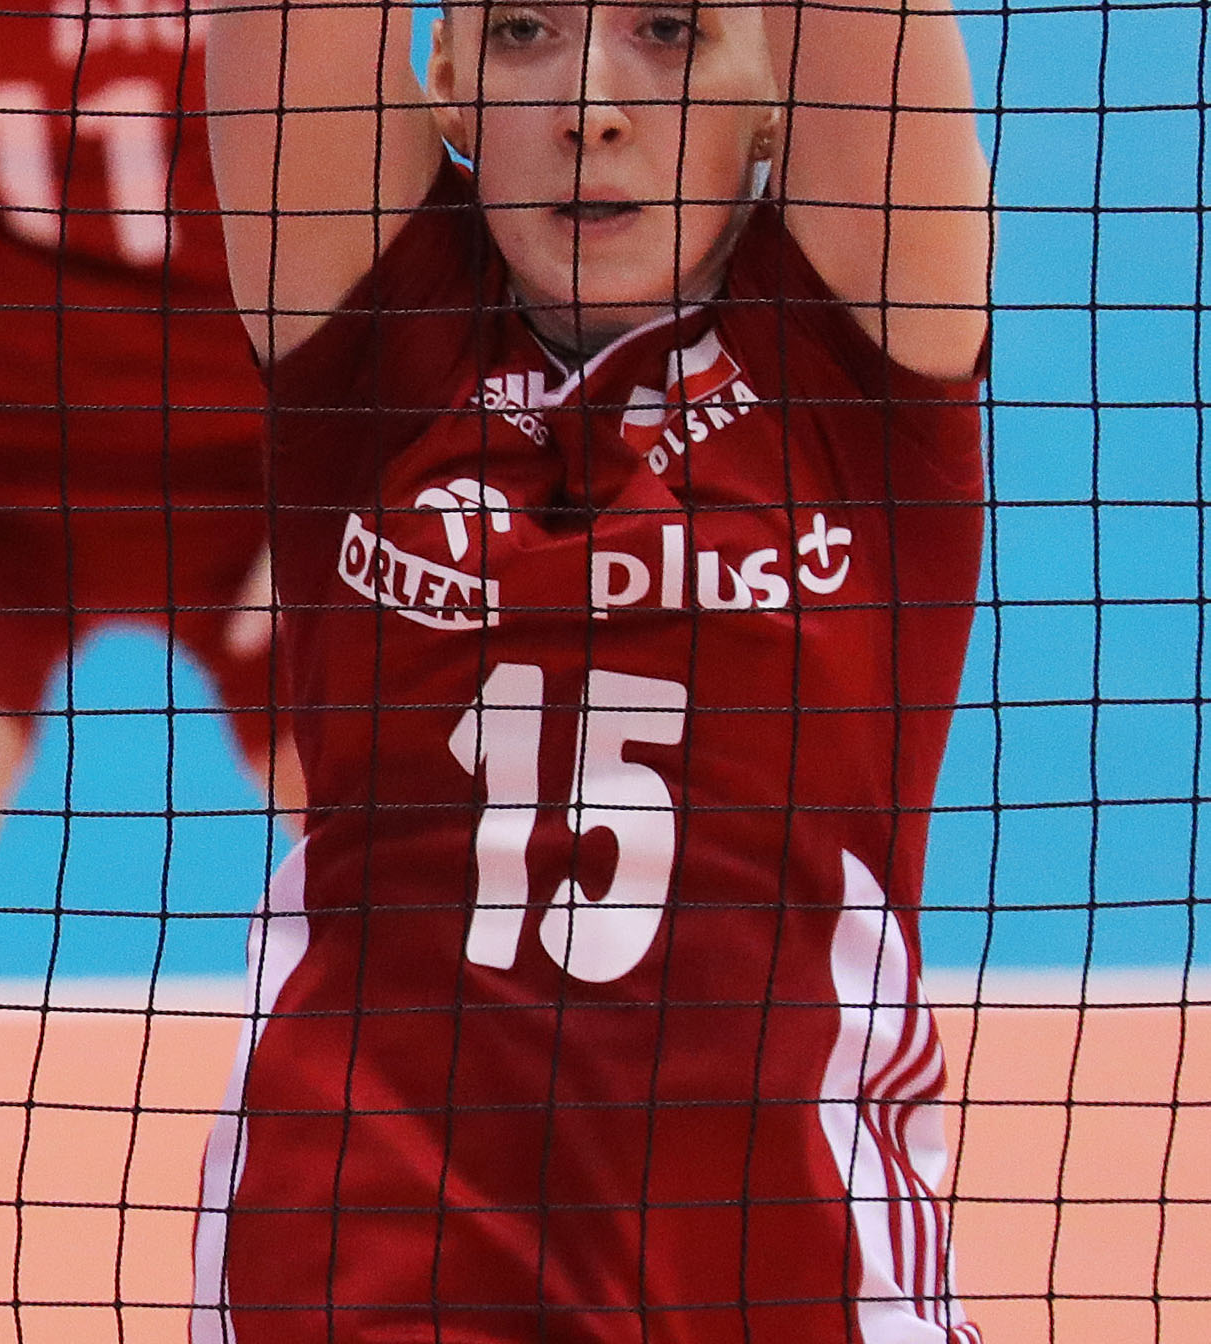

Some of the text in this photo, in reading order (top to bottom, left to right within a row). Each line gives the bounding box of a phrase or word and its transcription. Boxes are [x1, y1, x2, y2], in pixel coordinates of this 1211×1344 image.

[470, 392, 549, 446] didas
[643, 380, 760, 476] OLSKA
[345, 535, 487, 623] ORLEN
[592, 524, 790, 620] plus
[448, 662, 688, 983] 15
